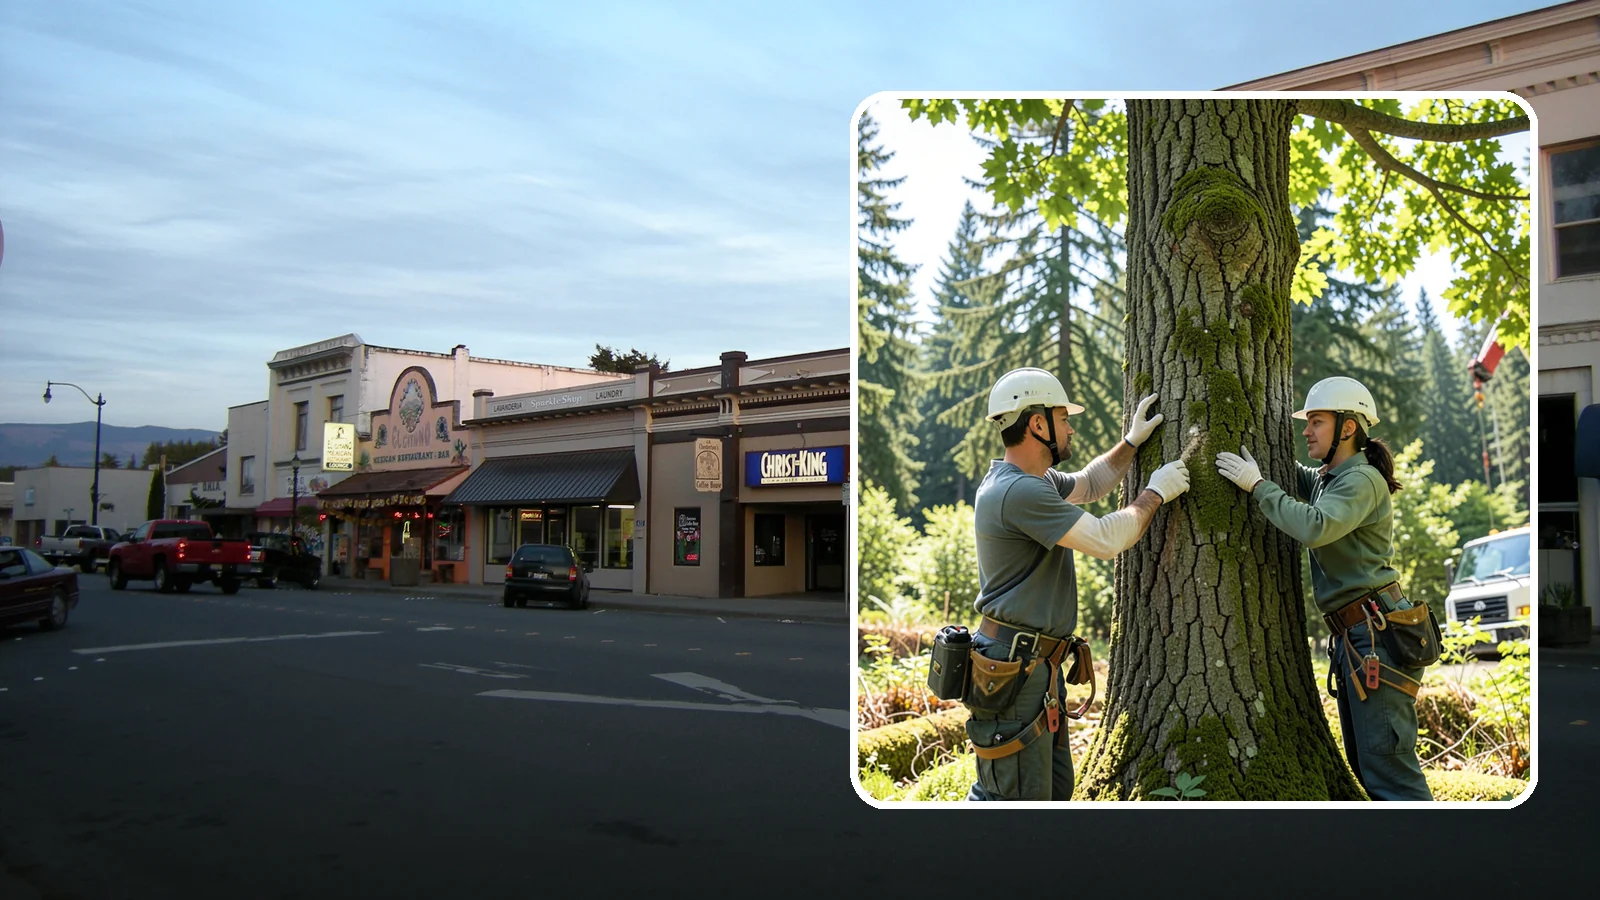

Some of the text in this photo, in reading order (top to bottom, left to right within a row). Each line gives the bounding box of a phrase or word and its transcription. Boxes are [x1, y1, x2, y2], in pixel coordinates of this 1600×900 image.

[493, 389, 623, 412] LAVANDERIA Sparkle Shop LAUNDRY
[373, 454, 396, 464] MEXICAN
[397, 451, 433, 462] RESTAURANT
[437, 450, 450, 459] BAR
[799, 450, 827, 476] KING
